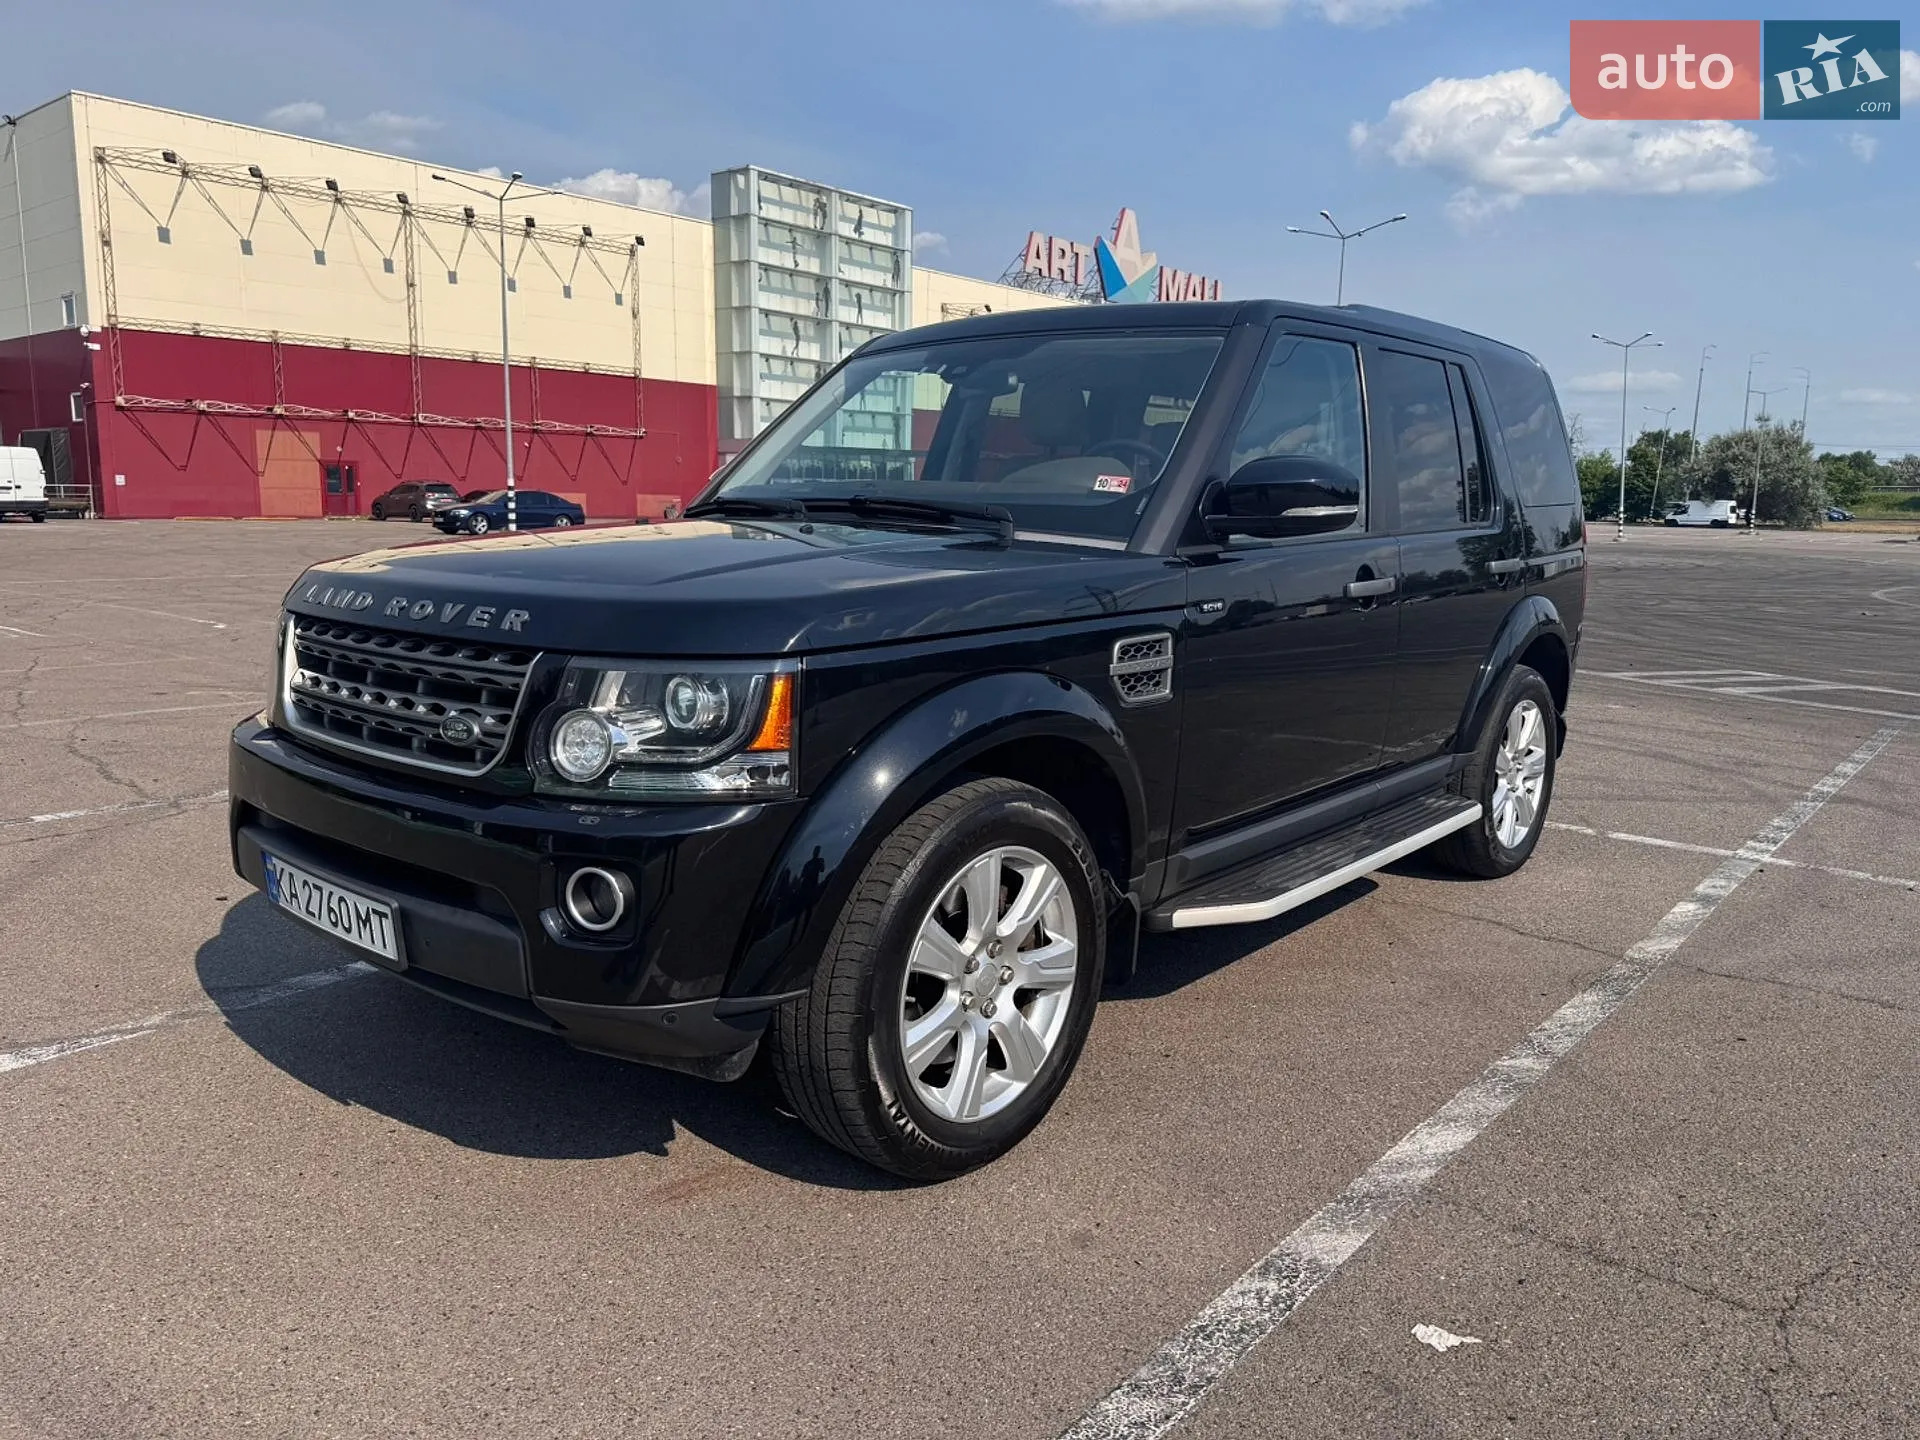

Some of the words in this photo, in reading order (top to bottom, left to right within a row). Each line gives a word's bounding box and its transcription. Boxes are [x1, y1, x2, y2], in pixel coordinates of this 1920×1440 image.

[1023, 231, 1091, 287] ART
[1097, 478, 1109, 489] 10
[303, 584, 374, 612] LAND
[383, 596, 531, 632] ROVER
